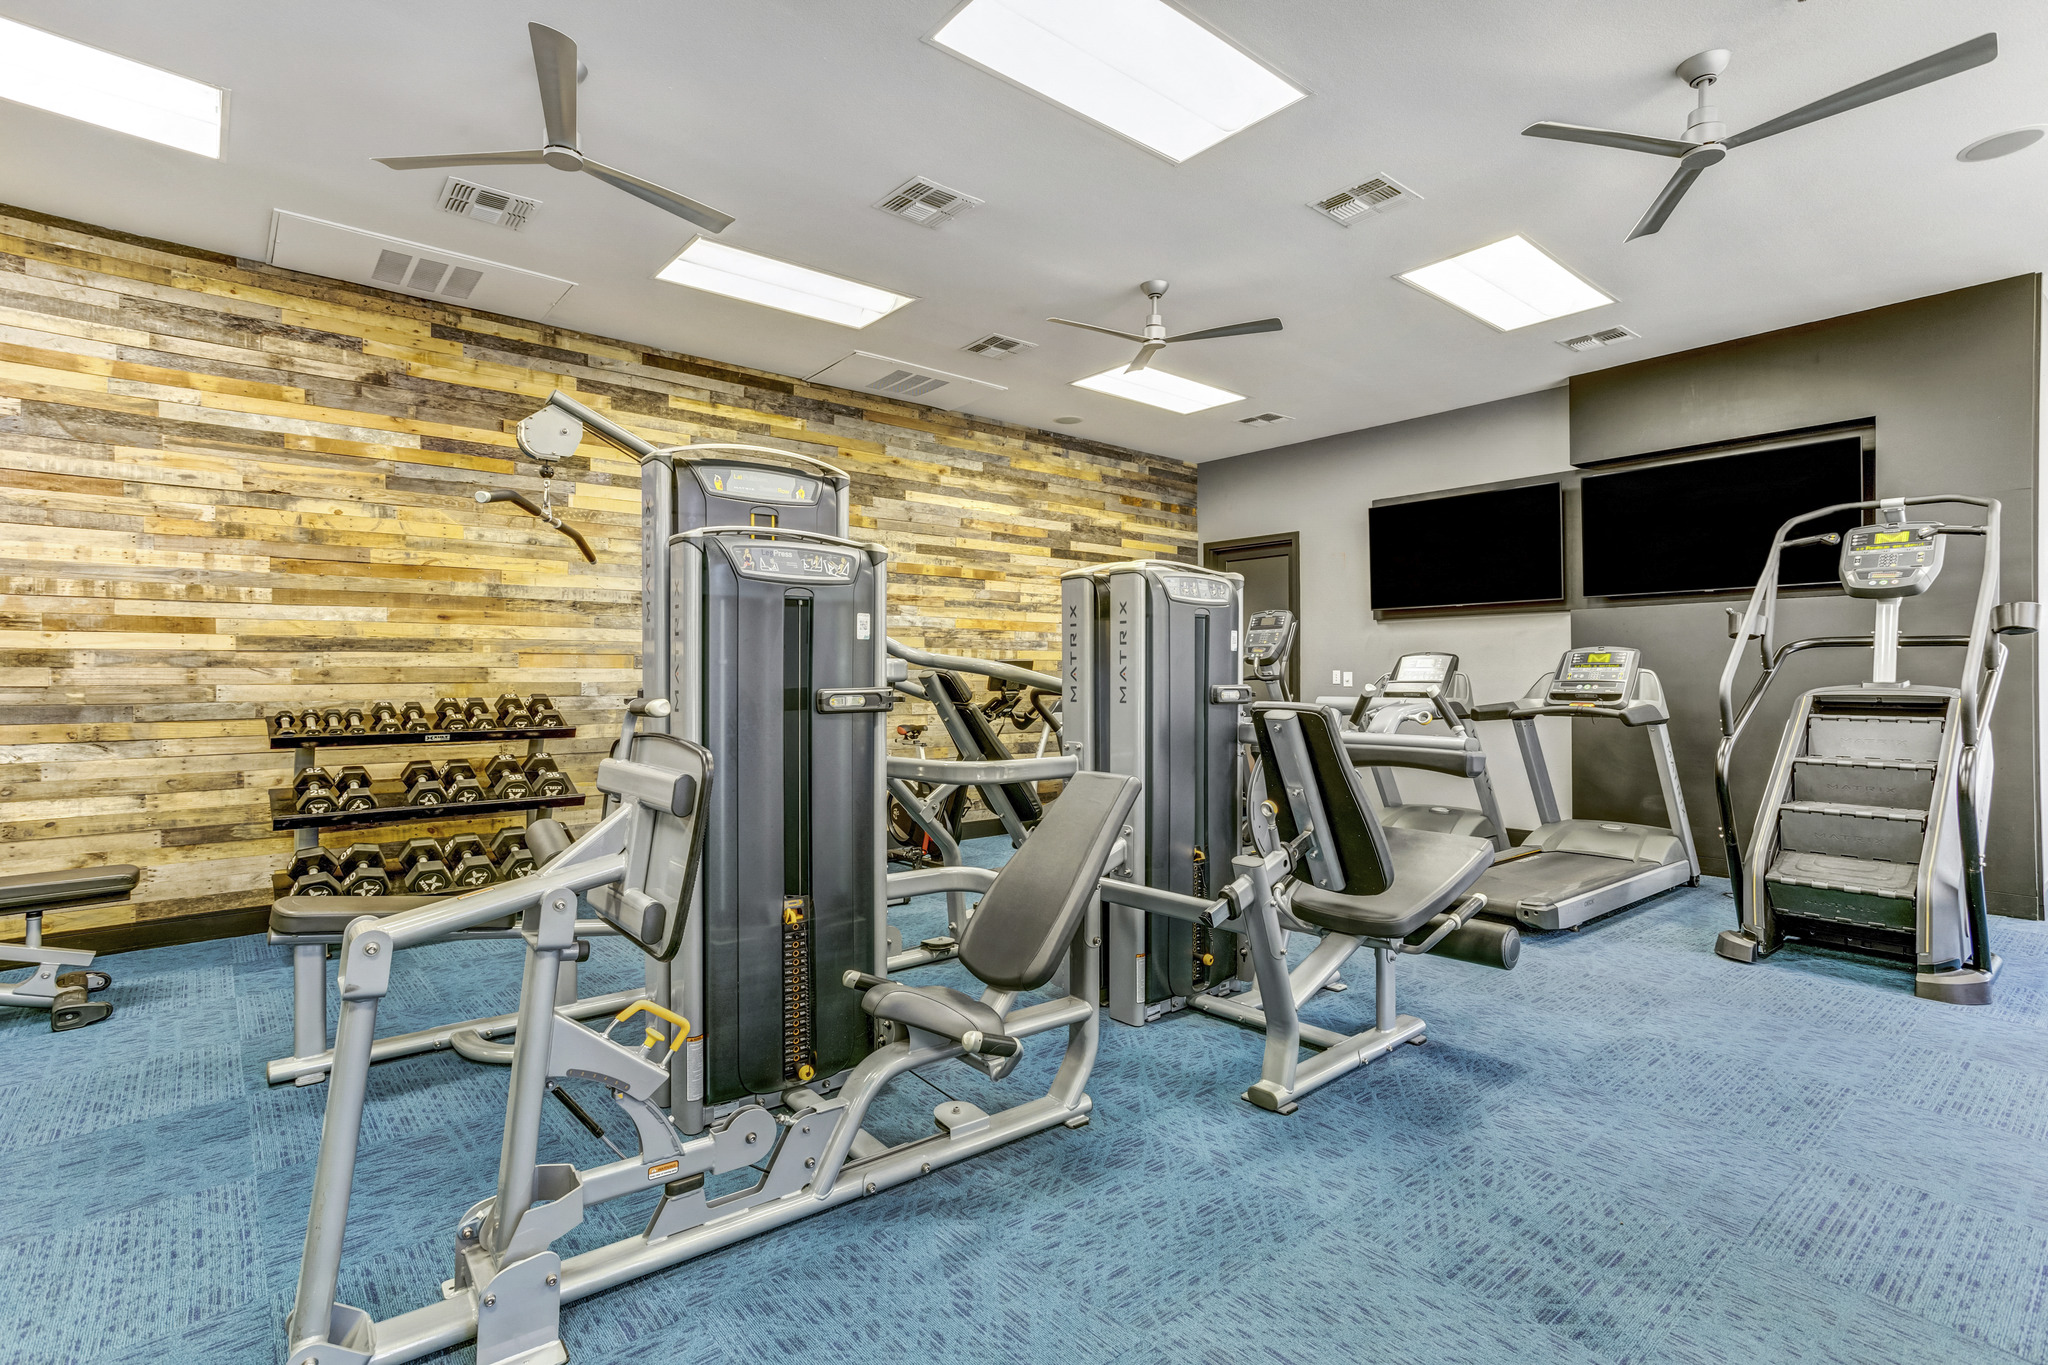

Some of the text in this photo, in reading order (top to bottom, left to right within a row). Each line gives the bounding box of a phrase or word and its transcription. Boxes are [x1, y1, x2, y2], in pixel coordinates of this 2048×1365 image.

[1069, 604, 1078, 703] MATRIX
[1119, 601, 1128, 704] MATRIX
[309, 788, 326, 796] 25
[447, 783, 457, 796] 30
[1826, 783, 1897, 794] MATRIX
[454, 861, 465, 876] 45
[343, 872, 357, 886] 40
